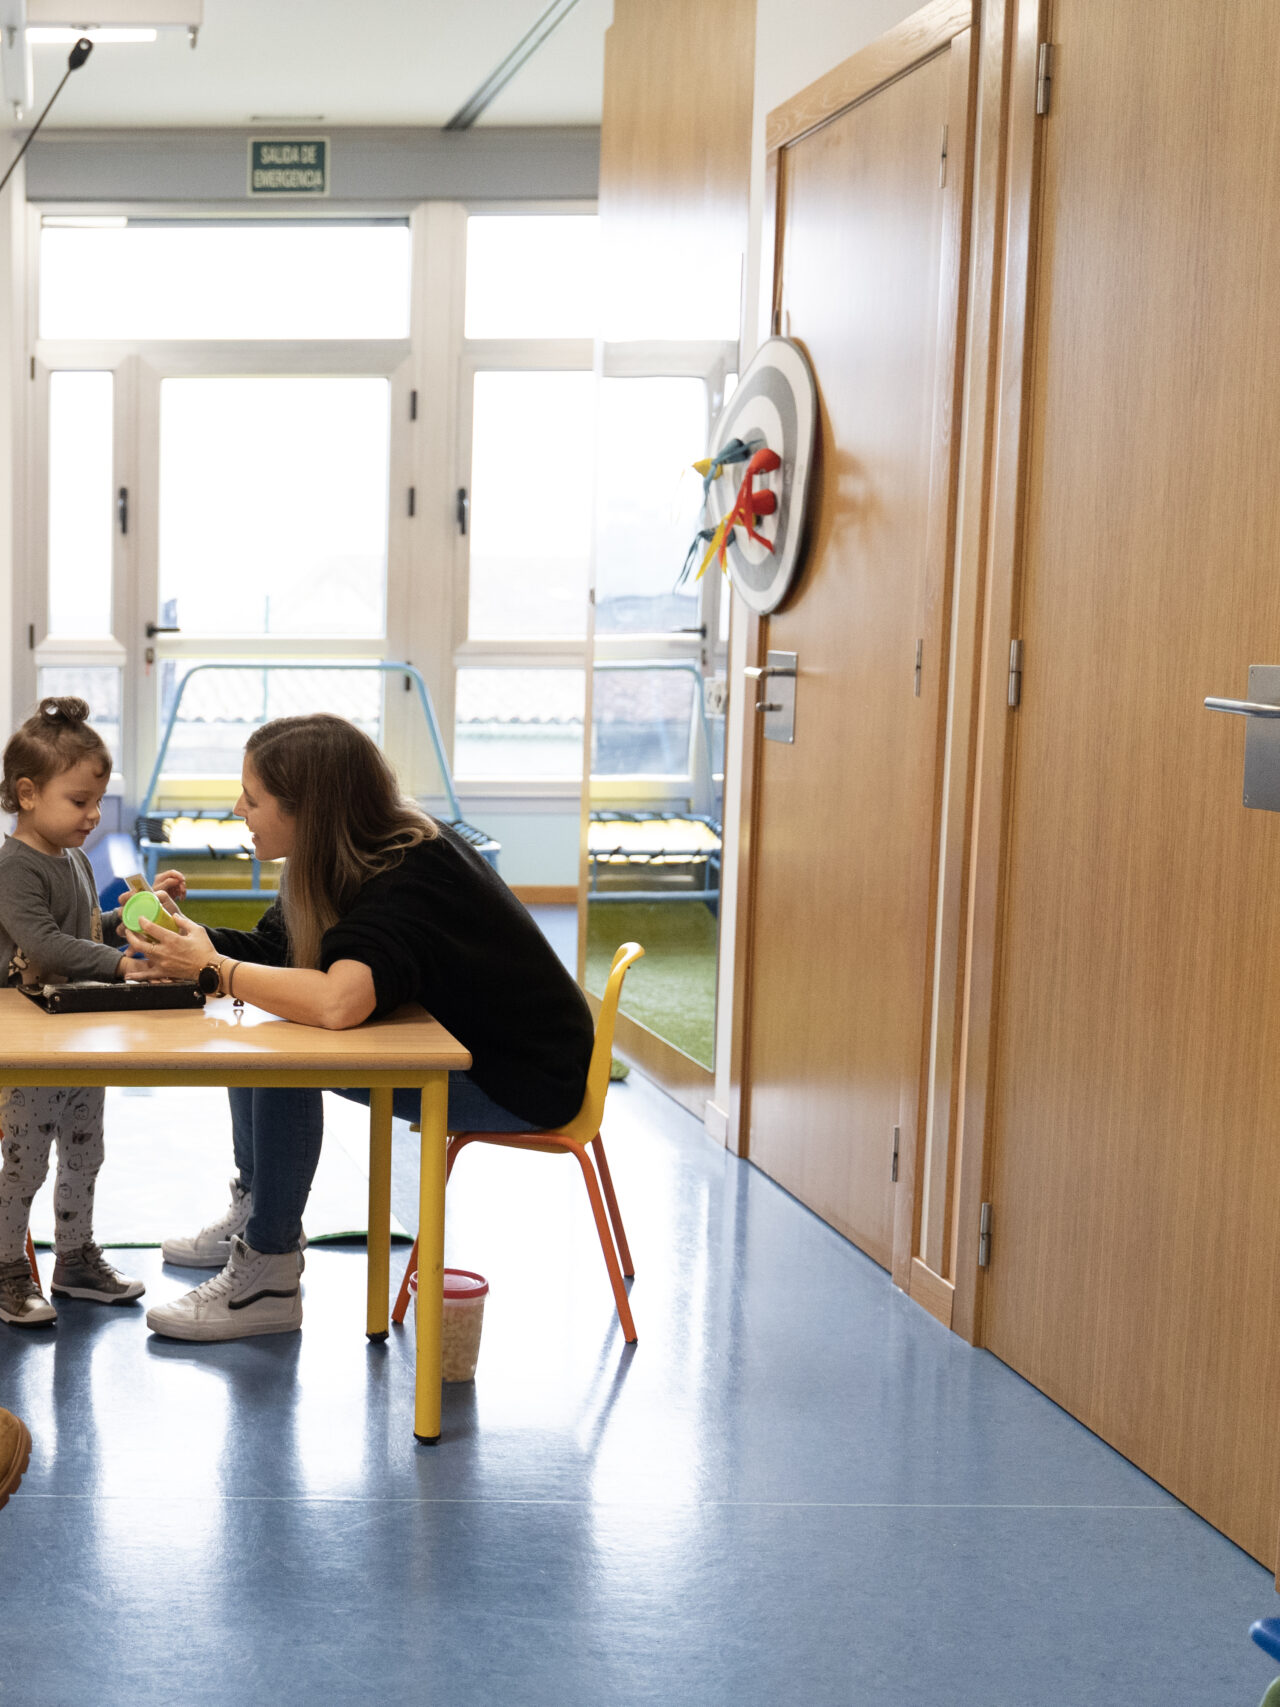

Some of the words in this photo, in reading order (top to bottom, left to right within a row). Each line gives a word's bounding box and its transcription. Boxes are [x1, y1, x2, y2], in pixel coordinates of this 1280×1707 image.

[261, 145, 299, 164] SALIDA
[301, 145, 317, 164] DE
[254, 170, 322, 188] EMERGENCIA
